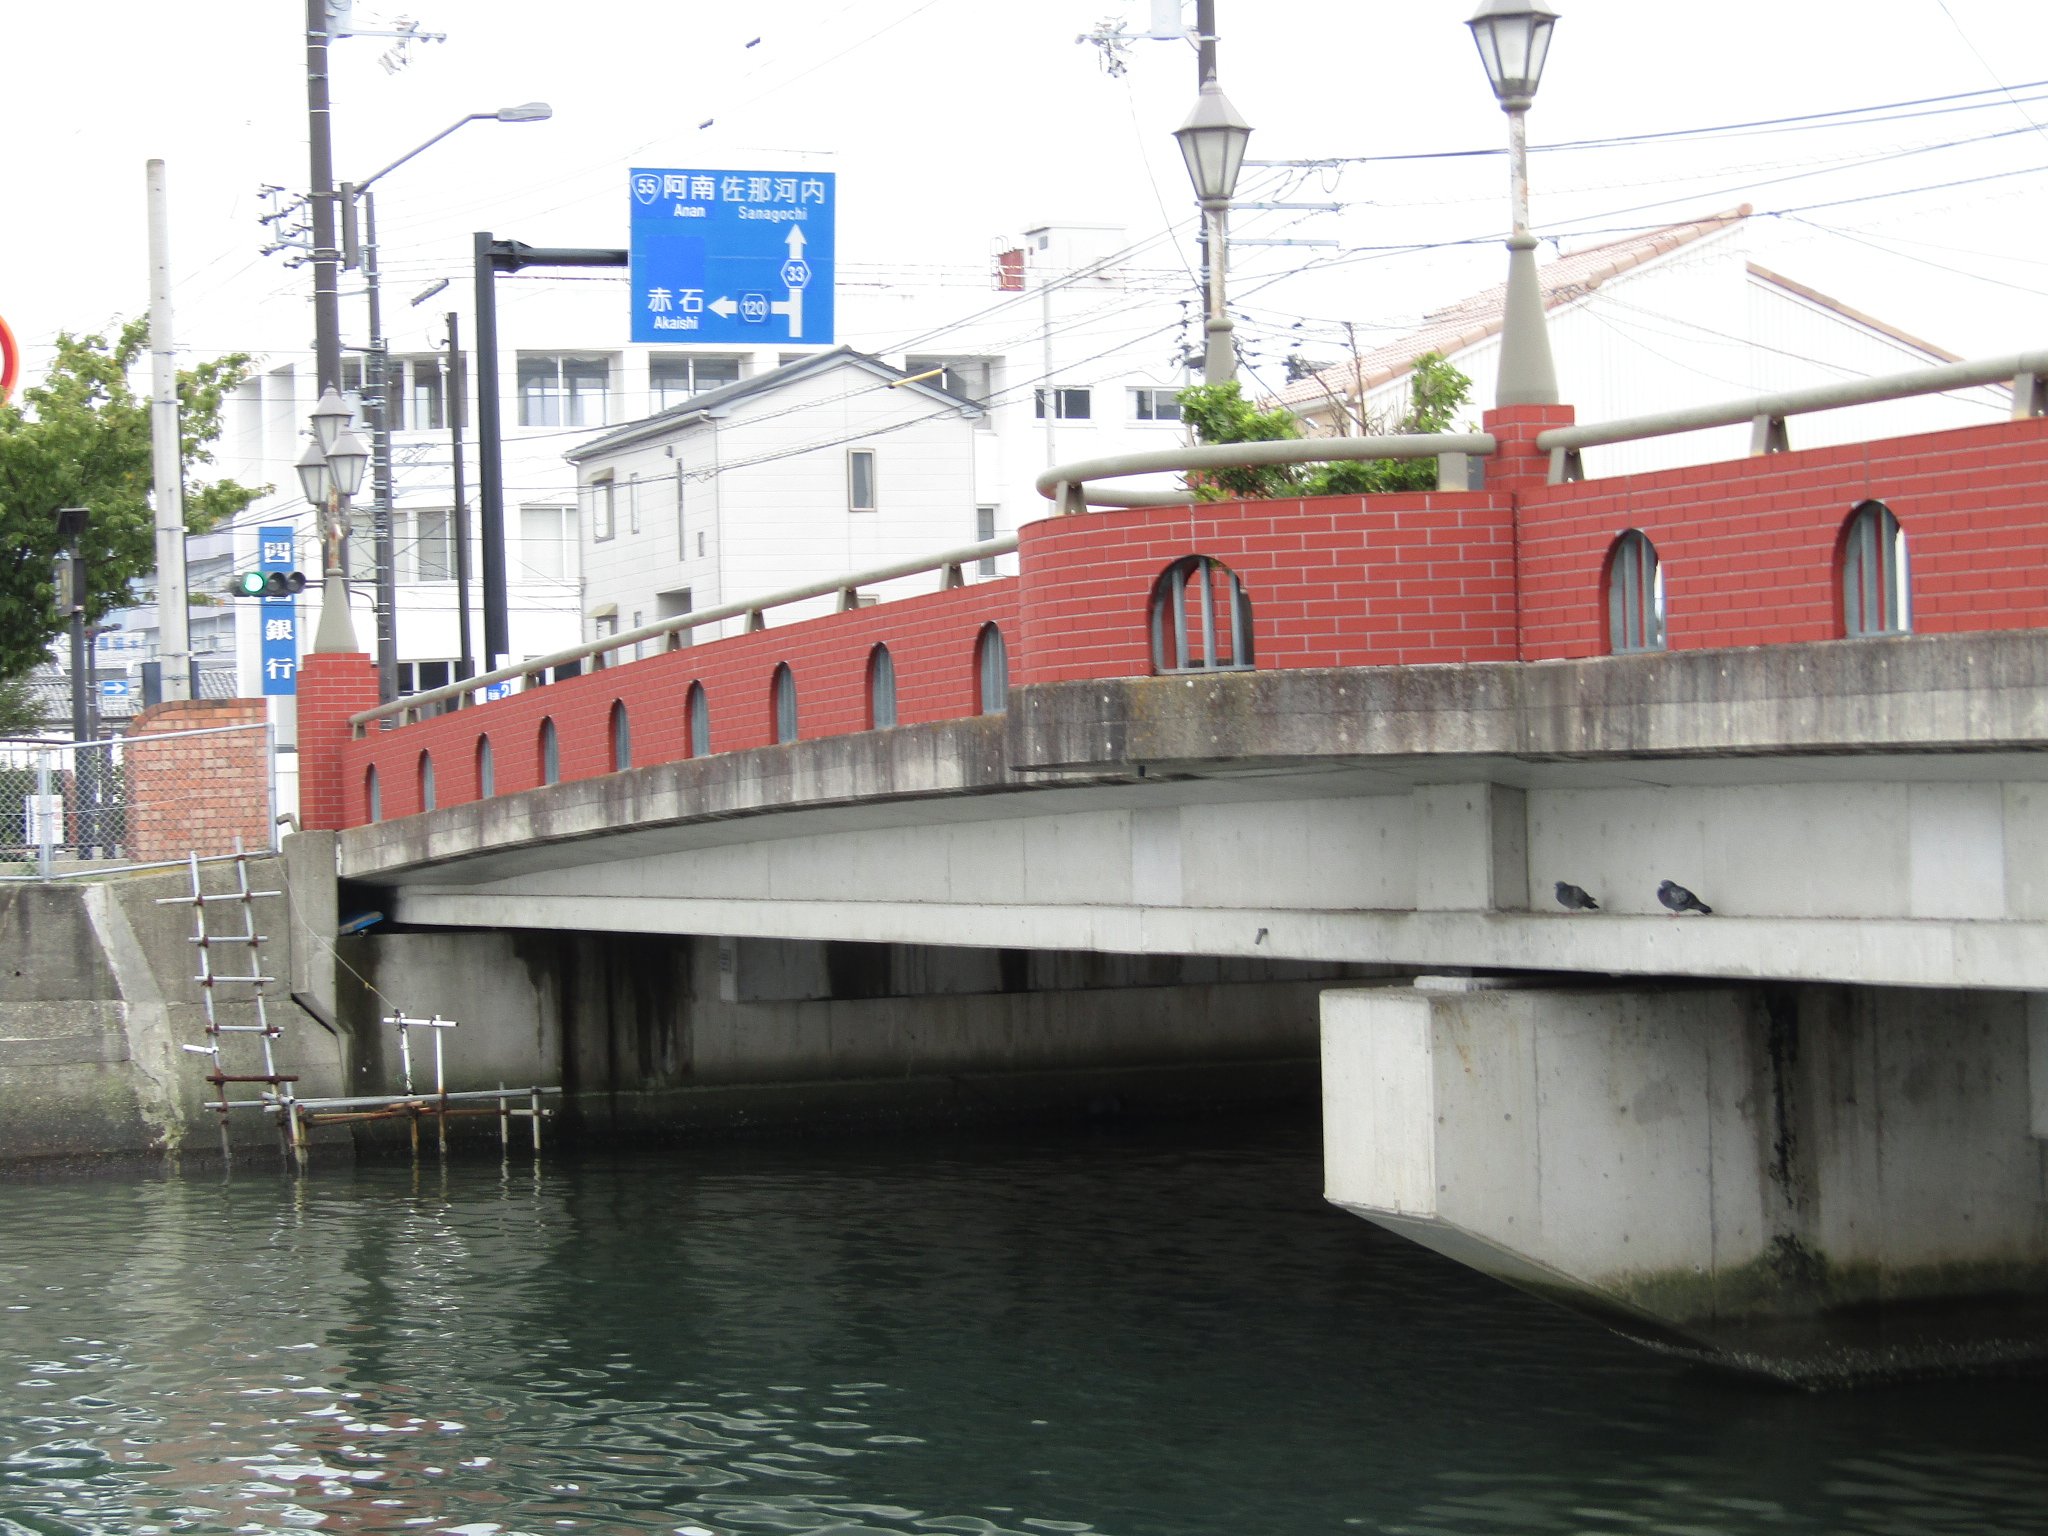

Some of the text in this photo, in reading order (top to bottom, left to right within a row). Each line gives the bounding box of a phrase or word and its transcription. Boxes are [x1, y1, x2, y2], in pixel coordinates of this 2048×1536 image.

[637, 179, 656, 195] 55
[663, 174, 716, 200] 阿南
[720, 175, 825, 204] 佐那河内
[674, 203, 706, 217] Anan
[738, 206, 808, 223] Sanagochi
[787, 266, 804, 282] 33
[647, 287, 704, 313] 赤石
[742, 301, 765, 315] 120
[653, 316, 699, 329] Akaishi
